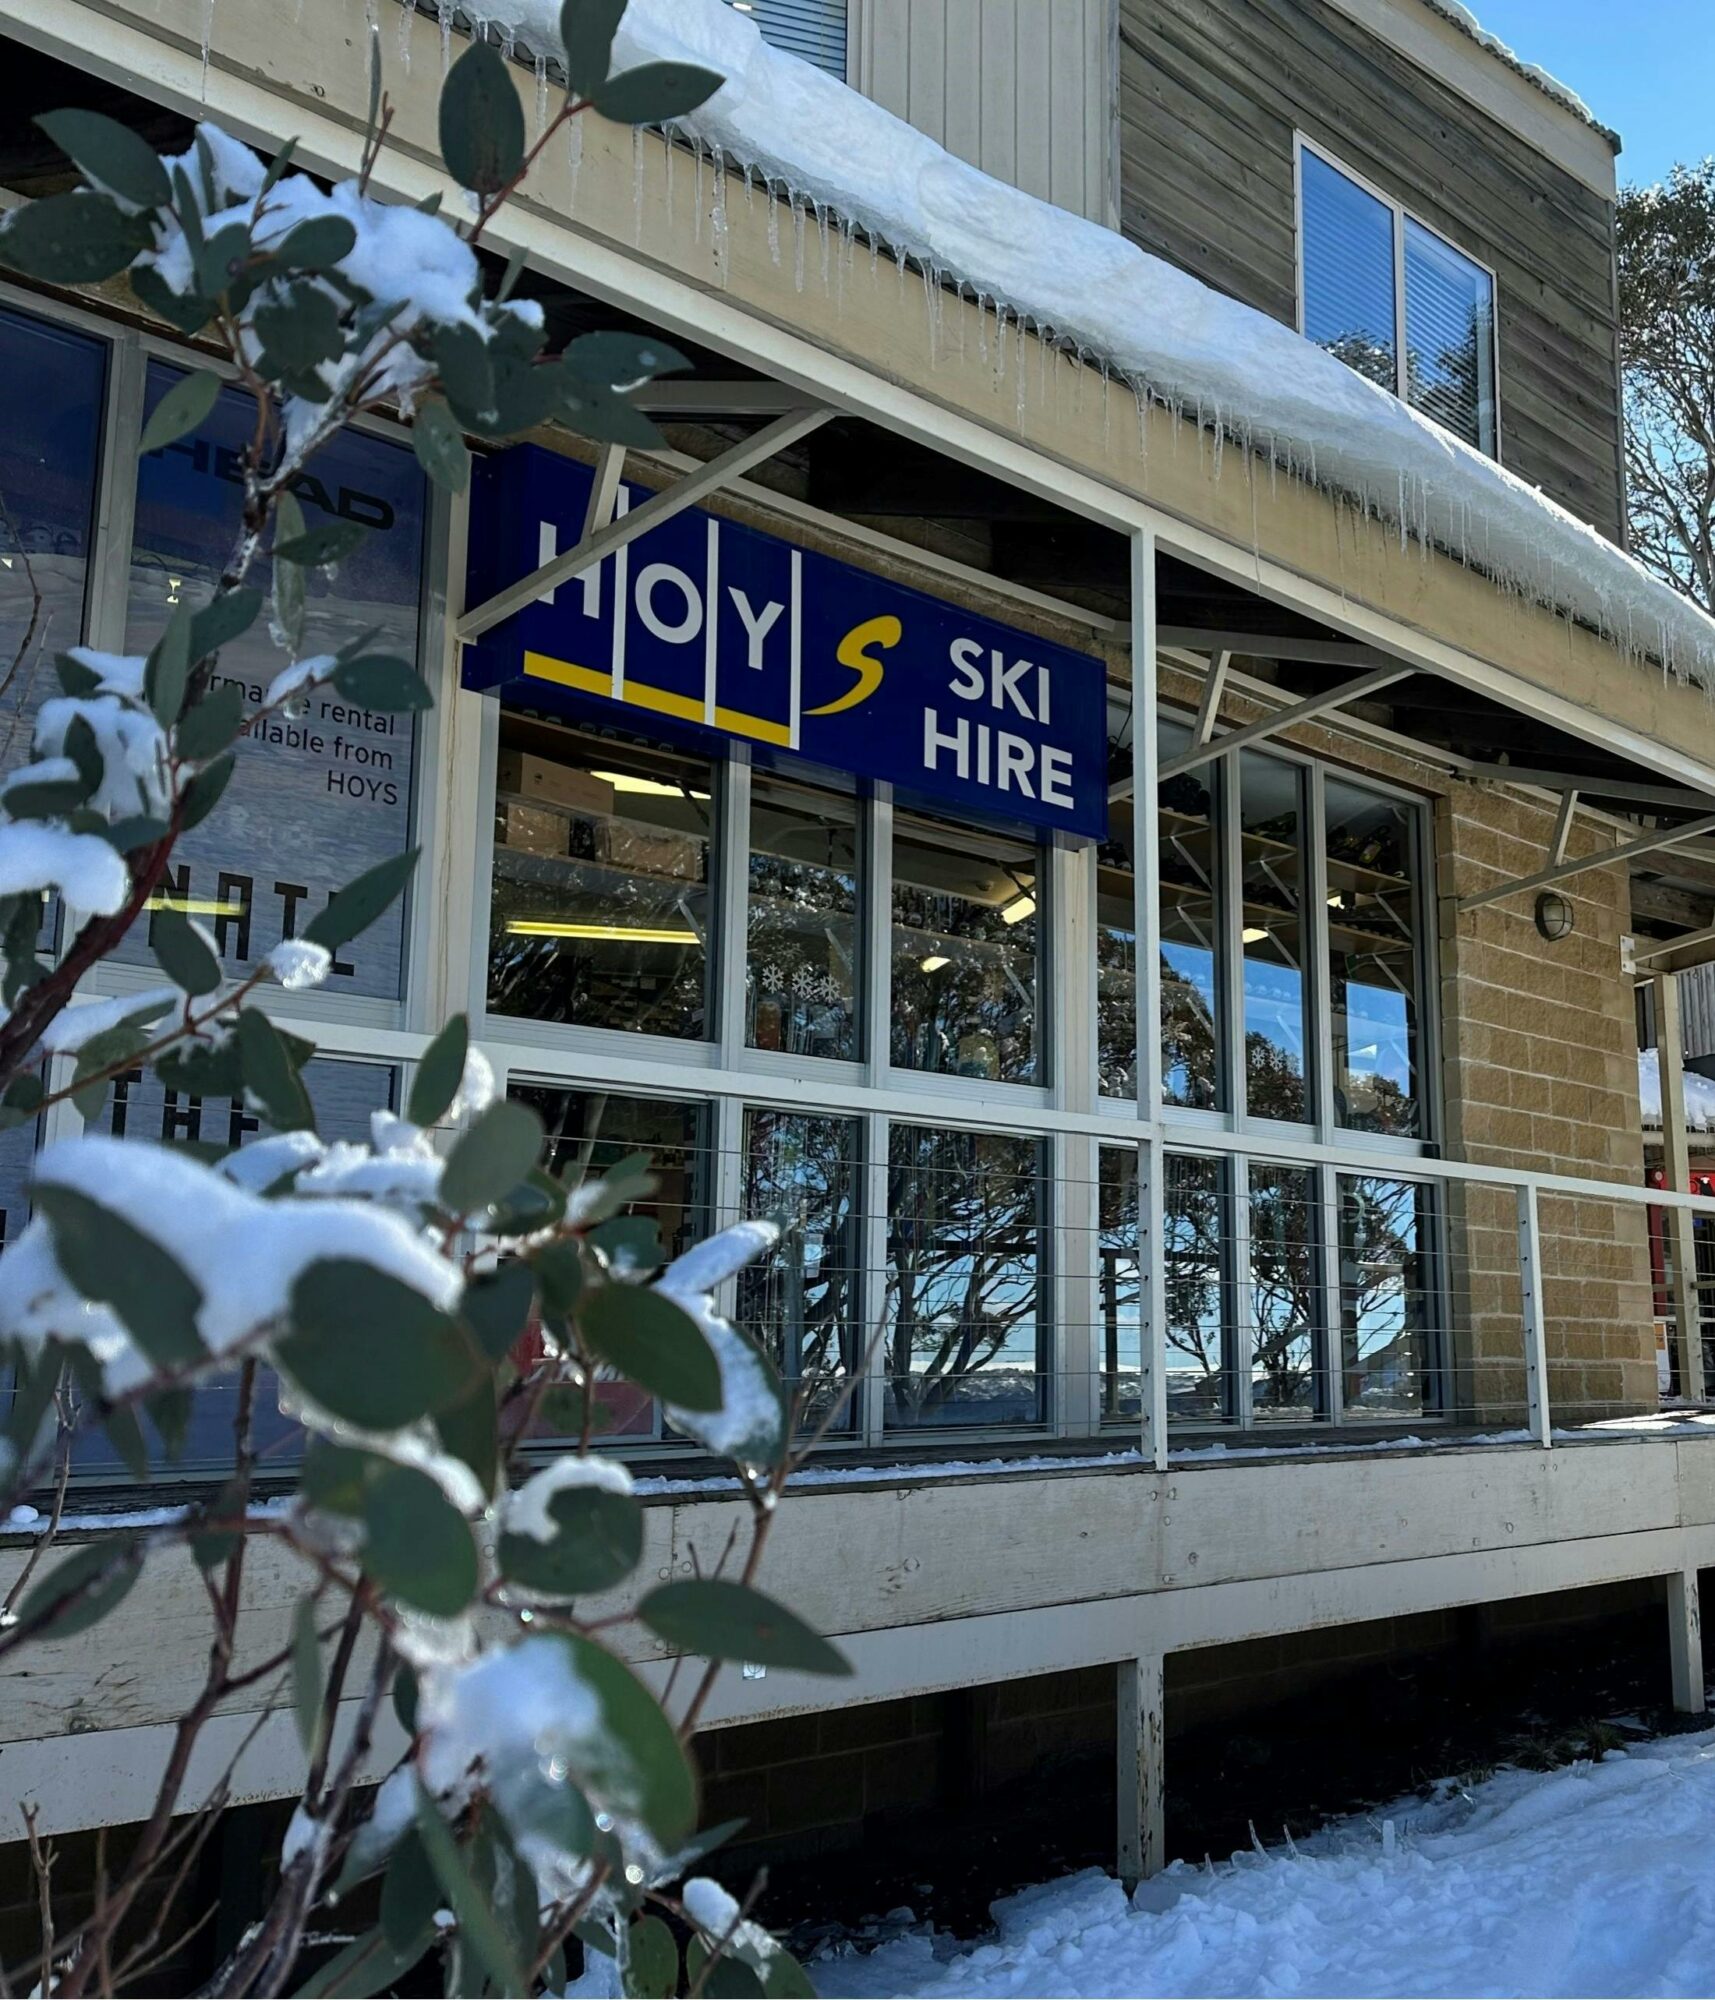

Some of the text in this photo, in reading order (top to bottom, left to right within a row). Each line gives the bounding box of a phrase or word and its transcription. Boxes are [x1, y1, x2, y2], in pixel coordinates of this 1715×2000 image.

[948, 637, 1050, 726] SKI
[320, 701, 395, 736] rental
[333, 734, 394, 771] from
[923, 706, 1075, 810] HIRE
[327, 768, 399, 806] HOYS
